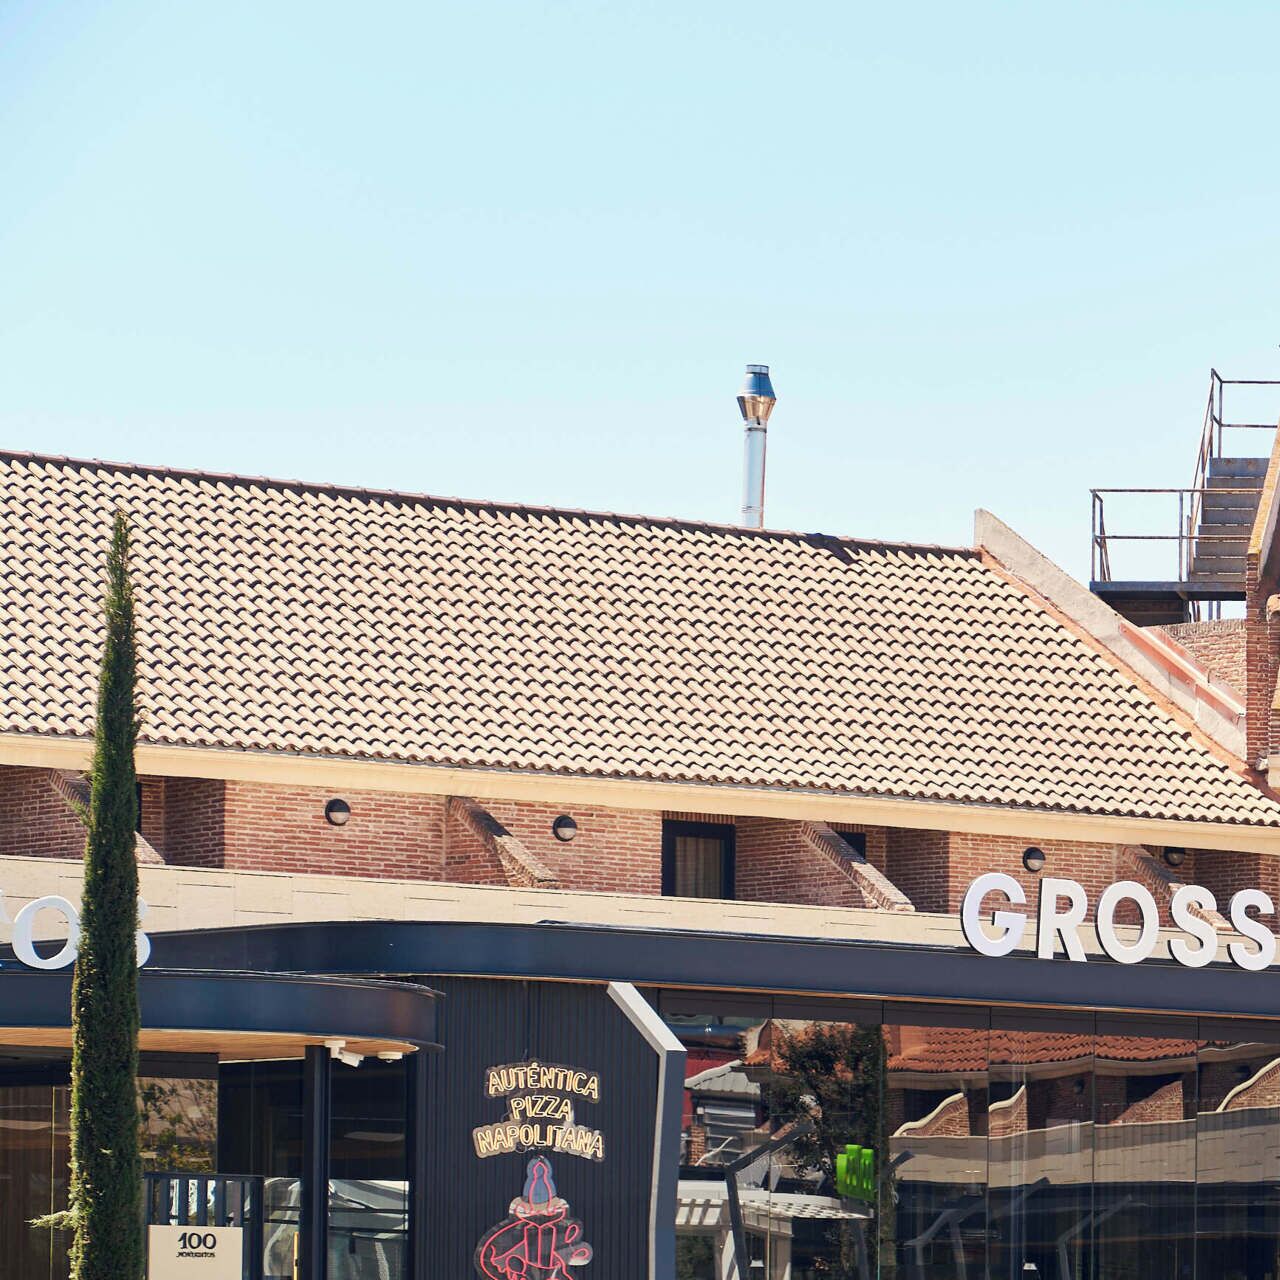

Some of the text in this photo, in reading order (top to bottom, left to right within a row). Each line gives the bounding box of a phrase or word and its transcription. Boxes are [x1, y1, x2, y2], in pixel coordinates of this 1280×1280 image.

[487, 1061, 599, 1099] AUTÉNTICA
[510, 1095, 573, 1122] PIZZA
[476, 1124, 604, 1158] NAPOLITANA
[178, 1232, 217, 1250] 100
